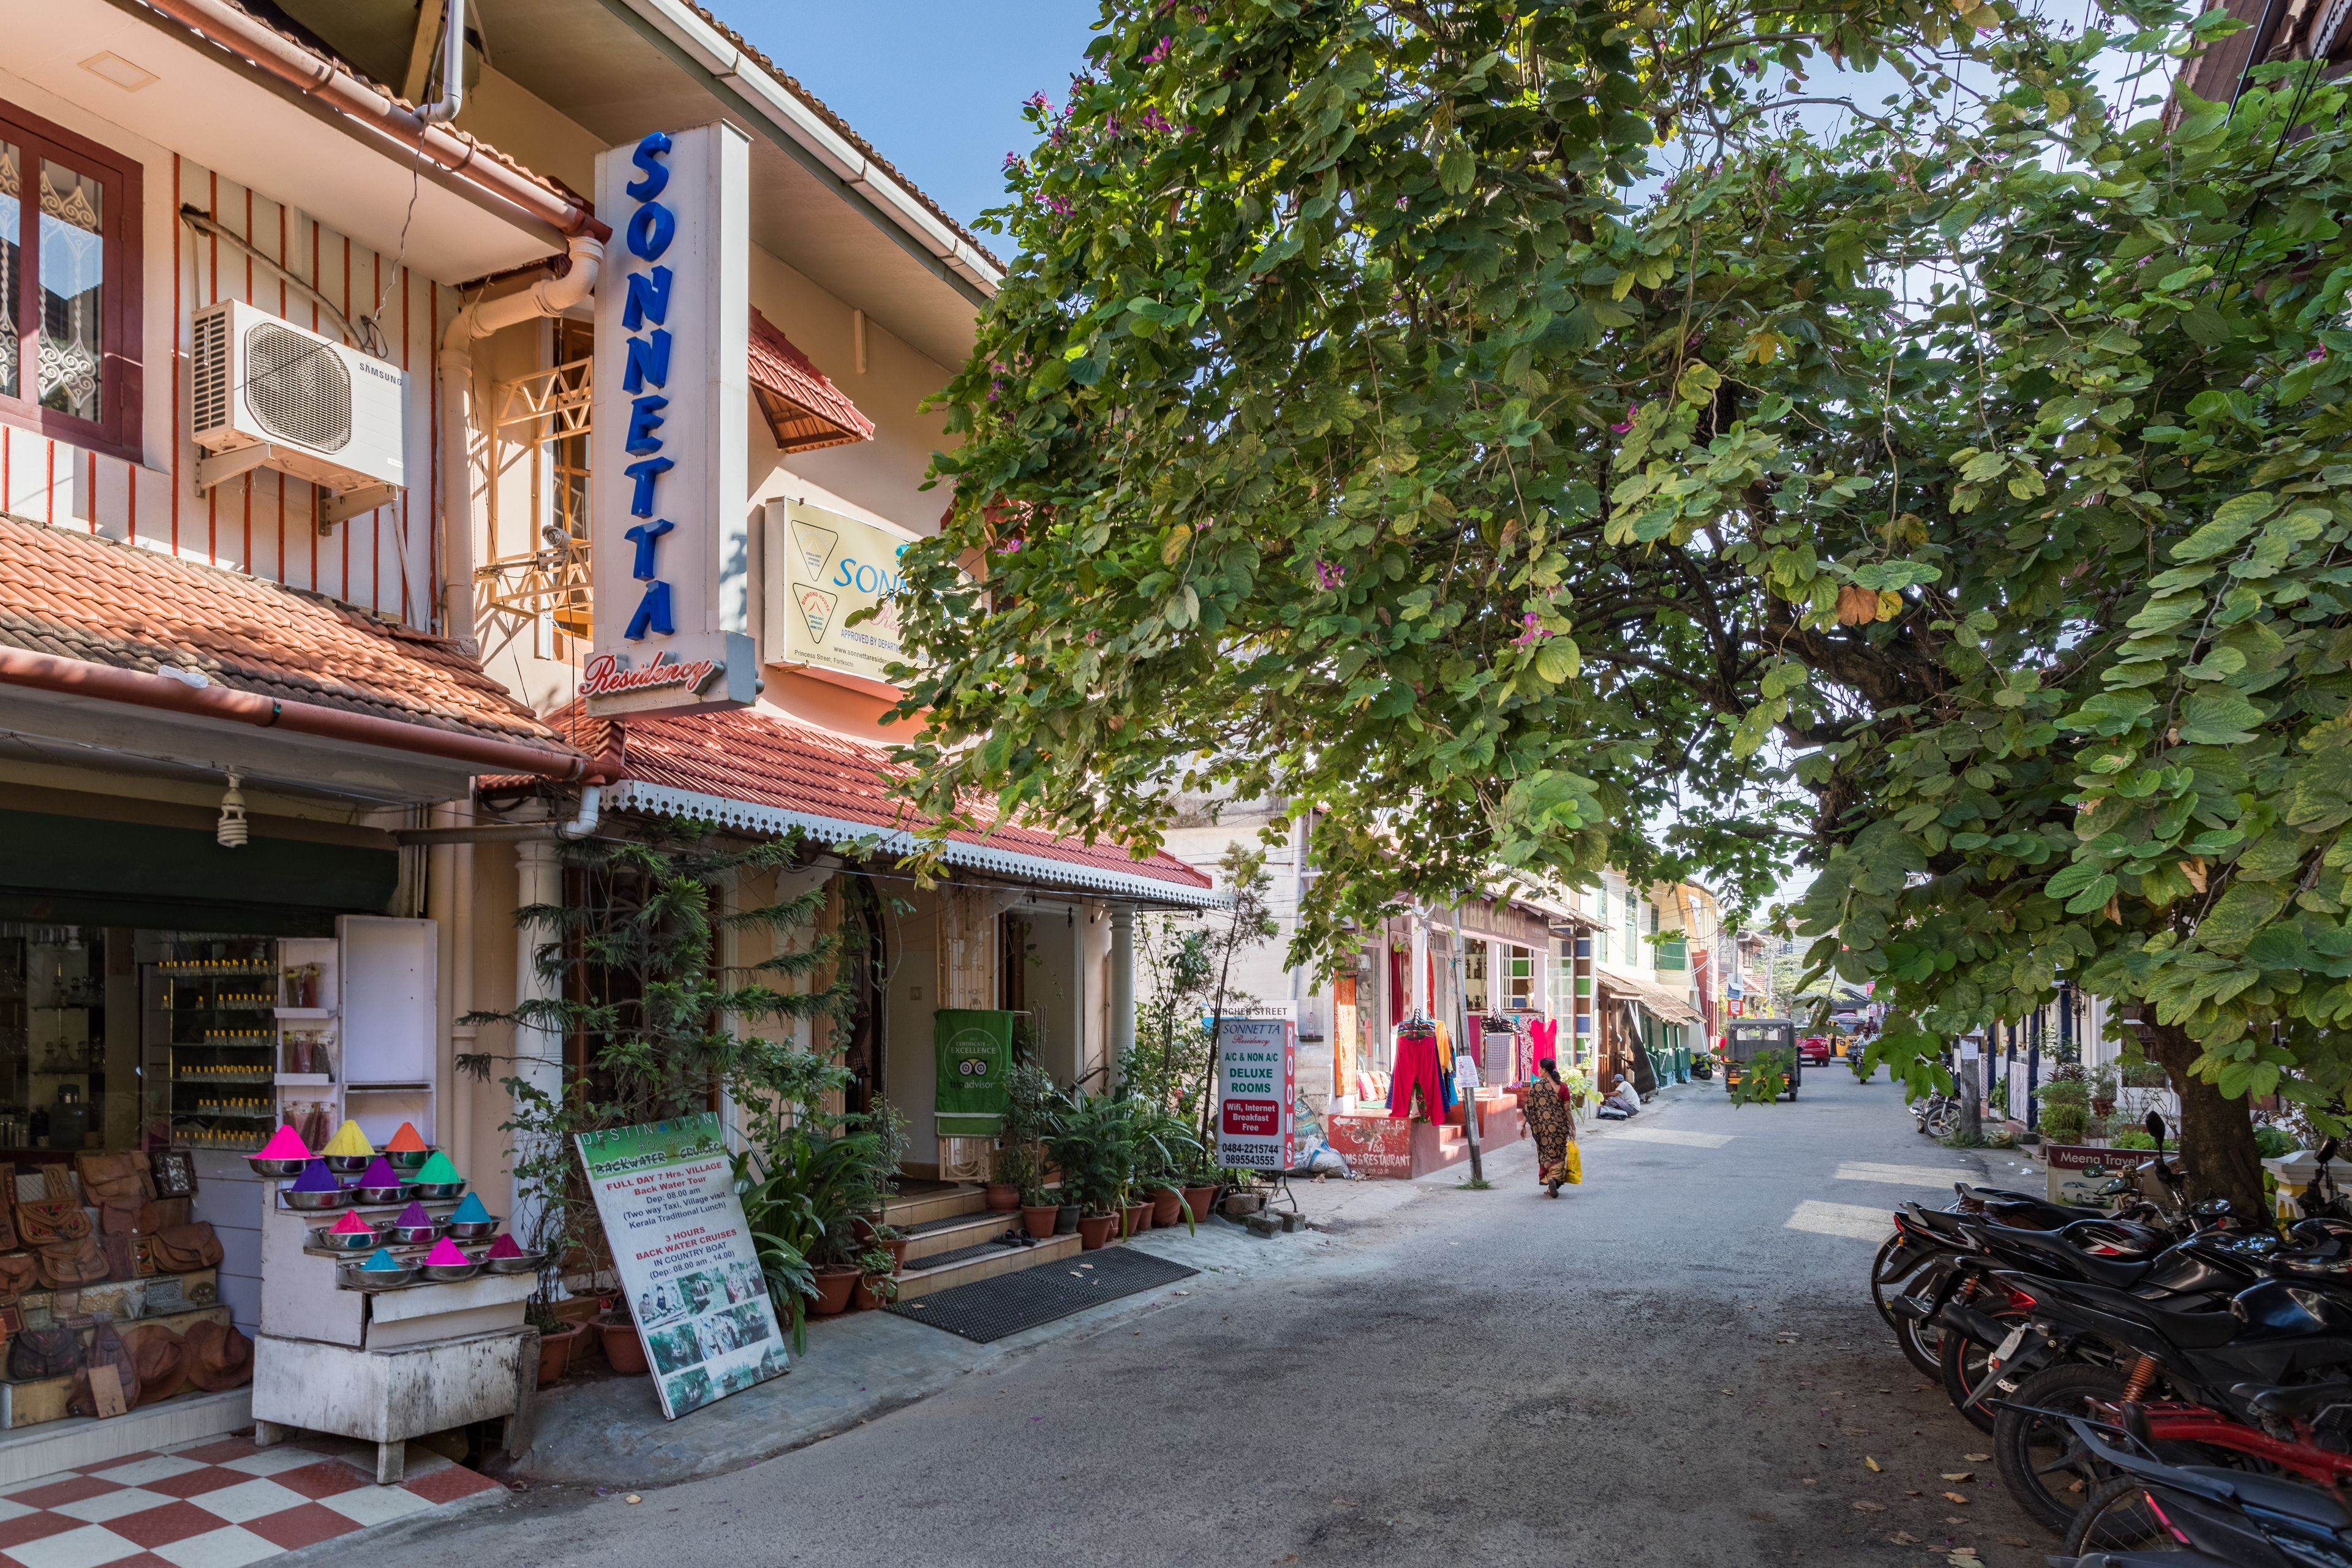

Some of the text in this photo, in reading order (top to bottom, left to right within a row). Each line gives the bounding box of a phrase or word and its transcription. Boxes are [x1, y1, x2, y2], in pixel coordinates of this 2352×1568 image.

[360, 363, 402, 386] SAMSUNG
[622, 131, 676, 641] SONNETTA
[801, 591, 818, 606] DIAMOND
[819, 595, 831, 612] HOUSE
[841, 628, 869, 644] APPROVED
[870, 636, 878, 646] BY
[794, 649, 854, 667] Princess Street, Fortkochi
[578, 650, 710, 697] Residency
[1462, 900, 1526, 938] THE CHOICE
[1223, 1024, 1280, 1035] SONNETTA
[1232, 1035, 1270, 1048] Residency
[1224, 1052, 1278, 1062] A/C & NON A/C
[1230, 1068, 1273, 1079] DELUXE
[950, 1080, 993, 1090] tripadvisor
[1231, 1083, 1271, 1093] ROOMS
[1226, 1103, 1276, 1113] Wifi, Internet
[1232, 1113, 1269, 1122] Breakfast
[1242, 1123, 1259, 1132] Free
[637, 1131, 696, 1152] HOLIDAYS
[1222, 1143, 1279, 1155] 0484-2215744
[595, 1142, 721, 1175] BACKWATER CRUISES
[1226, 1155, 1275, 1166] 9895543555
[2060, 1151, 2100, 1164] Meena
[2104, 1154, 2139, 1167] Travel
[606, 1180, 634, 1191] FULL
[636, 1175, 654, 1185] DAY
[665, 1169, 684, 1180] Hrs.
[685, 1162, 723, 1175] VILLAGE
[634, 1175, 707, 1196] Back Water Tour
[646, 1195, 665, 1204] Dep:
[667, 1189, 687, 1200] 08.00
[624, 1191, 726, 1221] (Two way Taxi, Village visit
[629, 1201, 726, 1229] Kerala Traditional Lunch)
[673, 1226, 706, 1240] HOURS
[636, 1229, 737, 1260] BACK WATER CRUISES
[654, 1242, 727, 1267] IN COUNTRY BOAT
[649, 1270, 672, 1280] (Dep:
[673, 1263, 694, 1273] 08.00
[713, 1250, 735, 1261] 14.00)
